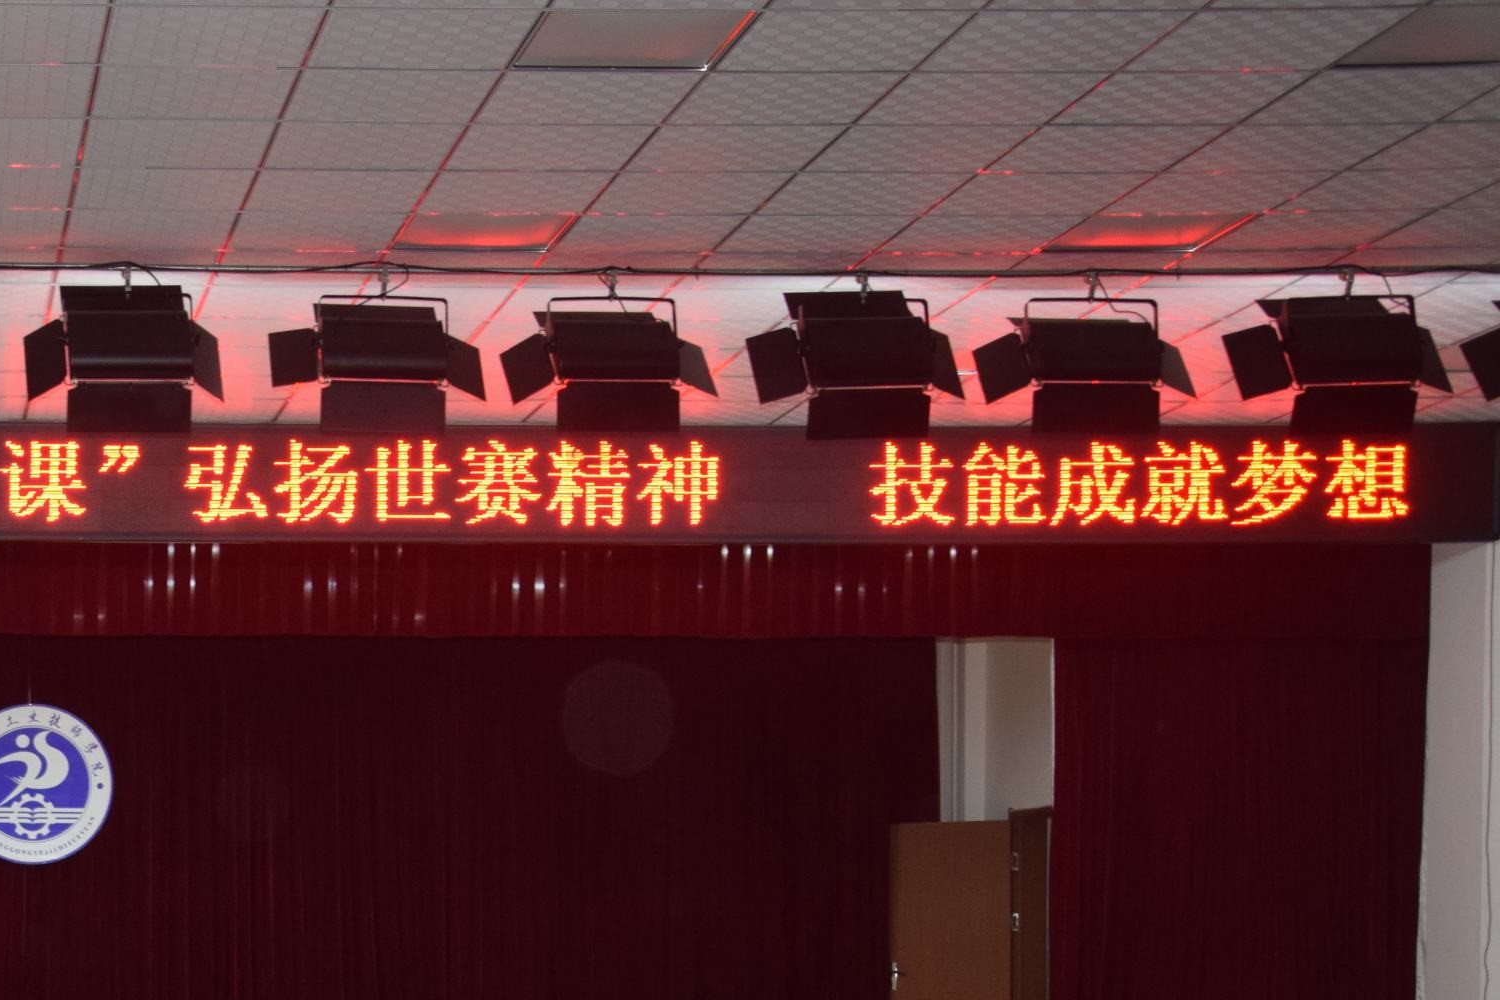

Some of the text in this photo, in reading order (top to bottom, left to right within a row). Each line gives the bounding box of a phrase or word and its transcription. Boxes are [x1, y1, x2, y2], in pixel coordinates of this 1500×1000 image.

[869, 440, 1409, 527] 技能成就梦想
